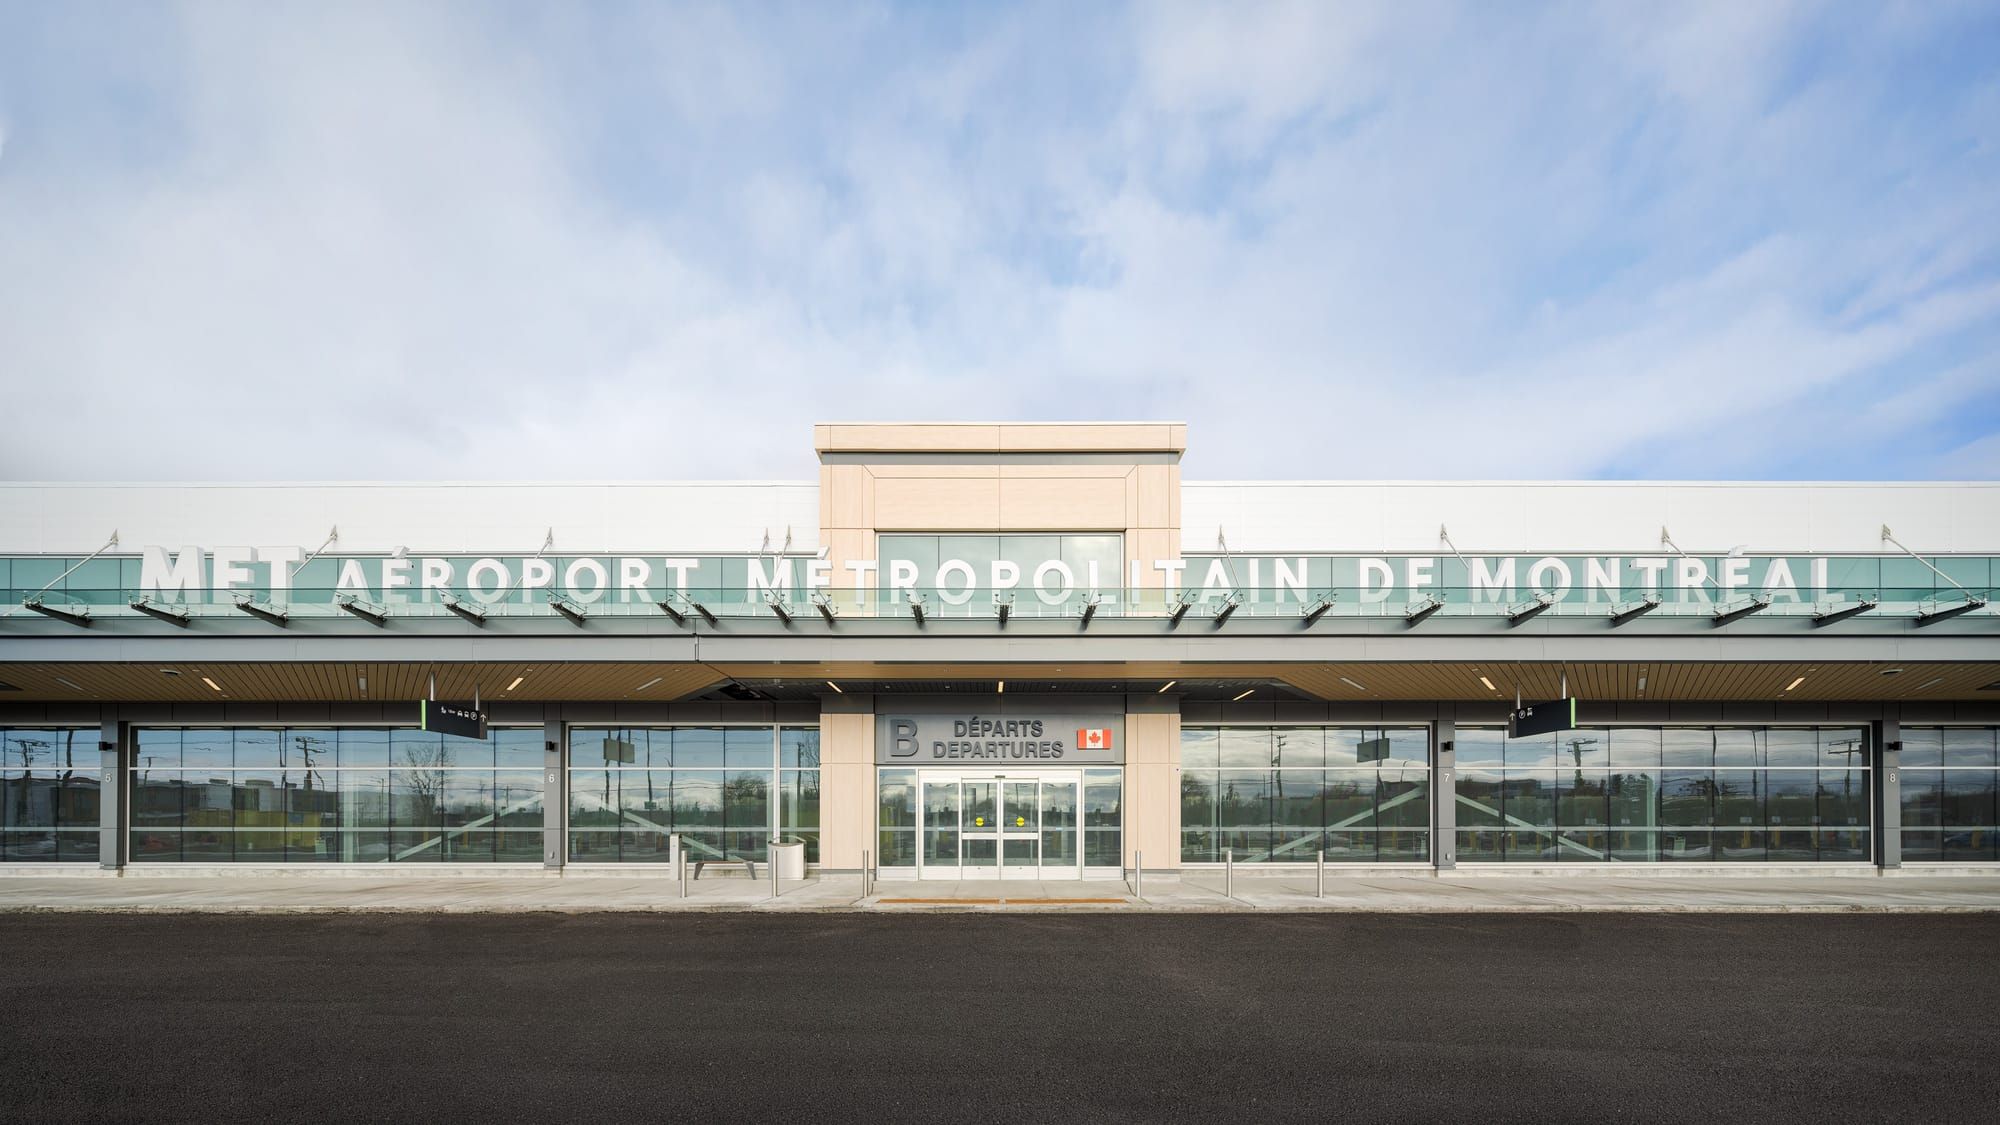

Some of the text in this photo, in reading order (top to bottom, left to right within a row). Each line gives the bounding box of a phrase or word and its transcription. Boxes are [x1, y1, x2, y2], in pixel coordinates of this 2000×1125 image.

[139, 544, 1845, 605] MET AÉROPORT MÉTROPOLITAIN DE MONTRÉAL
[953, 716, 1044, 738] DÉPARTS
[890, 718, 920, 757] B
[932, 741, 1064, 759] DEPARTURES
[548, 773, 555, 783] 6
[1444, 773, 1450, 782] 7
[1889, 773, 1896, 783] 8
